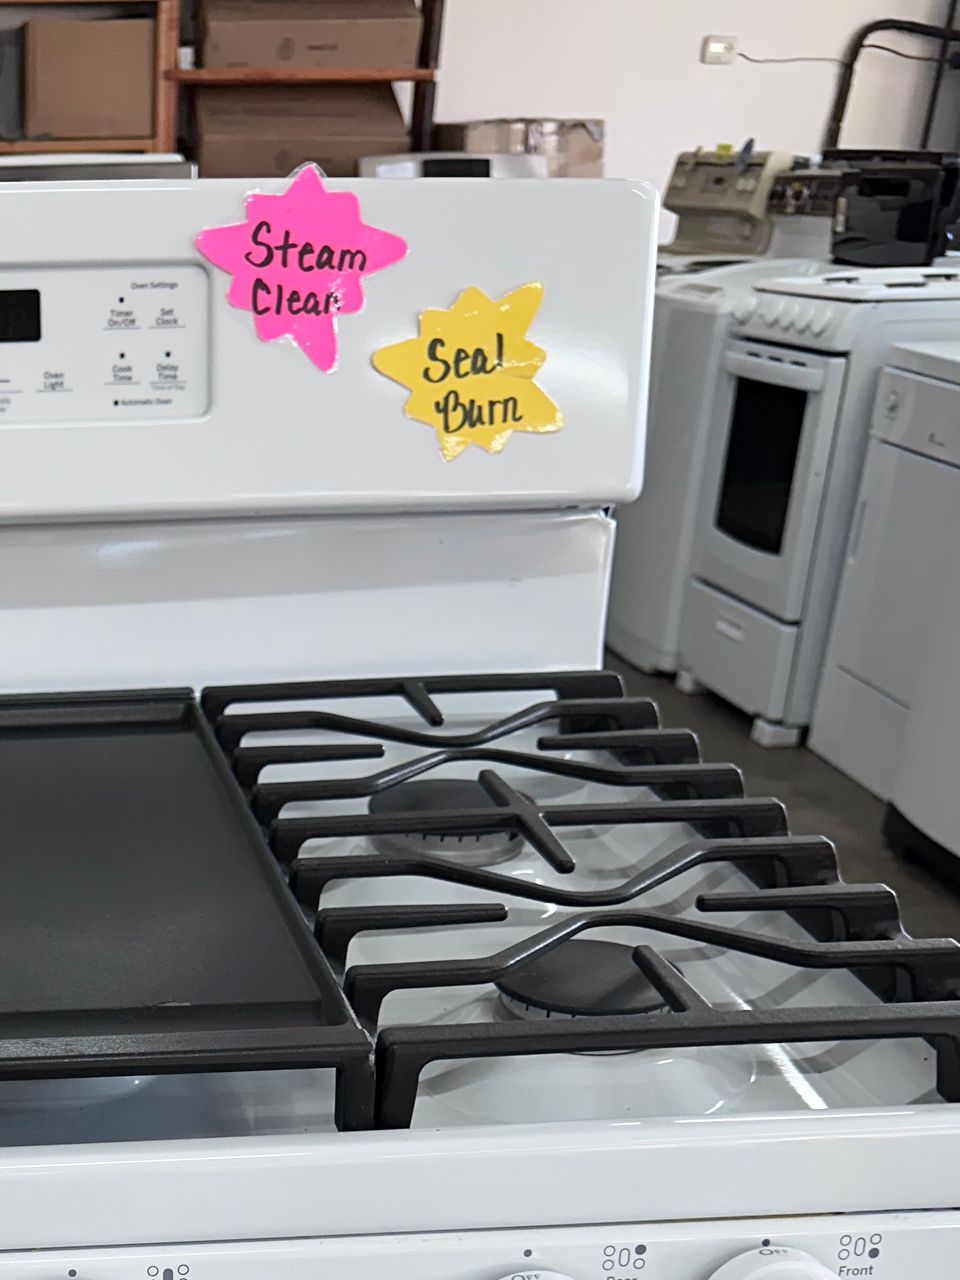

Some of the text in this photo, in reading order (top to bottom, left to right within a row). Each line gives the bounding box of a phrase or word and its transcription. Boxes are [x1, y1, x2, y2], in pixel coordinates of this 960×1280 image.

[244, 220, 367, 273] Steam
[130, 281, 178, 290] Oven Settings
[250, 278, 341, 317] Clean
[110, 308, 134, 317] Timer
[160, 307, 174, 316] Set
[155, 317, 178, 326] Clock
[422, 333, 504, 384] Seal
[111, 364, 133, 374] Cook
[155, 363, 179, 373] Delay
[43, 371, 64, 380] Oven
[112, 374, 133, 382] Time
[158, 373, 178, 382] Time
[43, 380, 64, 391] Light
[435, 390, 524, 434] Burn
[839, 1265, 874, 1276] Front
